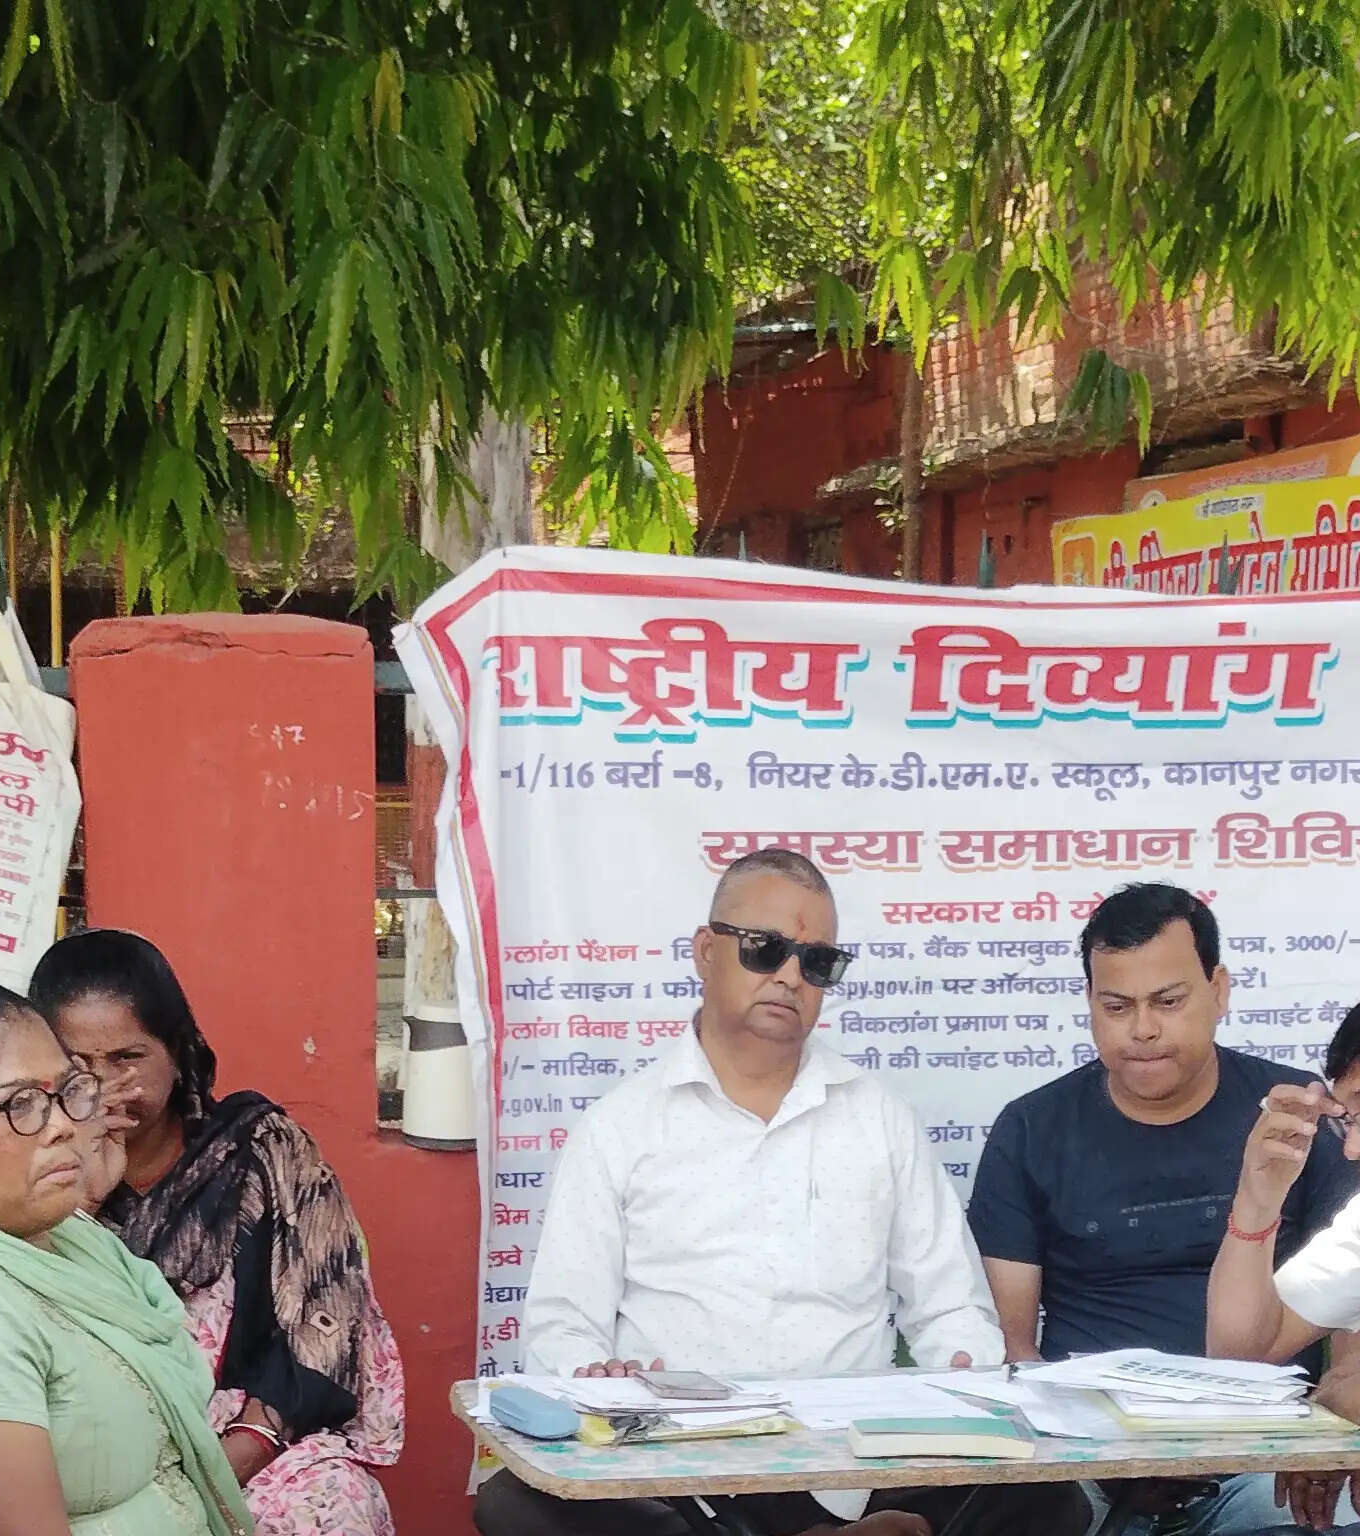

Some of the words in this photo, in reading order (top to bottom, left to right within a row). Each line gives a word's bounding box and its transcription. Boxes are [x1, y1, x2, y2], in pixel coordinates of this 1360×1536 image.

[483, 618, 860, 728] राष्ट्रीय
[897, 622, 1332, 716] दिव्यांग
[748, 751, 832, 790] नियर
[1051, 760, 1150, 801] स्कूल,
[1163, 760, 1283, 800] कानपुर
[940, 826, 1197, 864] समाधान
[881, 901, 1004, 925] सरकार
[1012, 892, 1061, 923] की
[576, 937, 640, 962] पेंशन
[867, 941, 914, 960] पत्र,
[924, 935, 971, 958] बैंक
[977, 940, 1080, 966] पासबुक,
[1227, 936, 1276, 954] पत्र,
[560, 982, 634, 1002] साइज
[942, 977, 975, 995] पर
[567, 1014, 630, 1038] विवाह
[839, 1011, 938, 1034] विकलांग
[944, 1015, 1009, 1035] प्रमाण
[1015, 1014, 1050, 1031] पत्र
[541, 1052, 625, 1077] मासिक,
[887, 1046, 921, 1069] की
[1003, 1045, 1064, 1068] फोटो,
